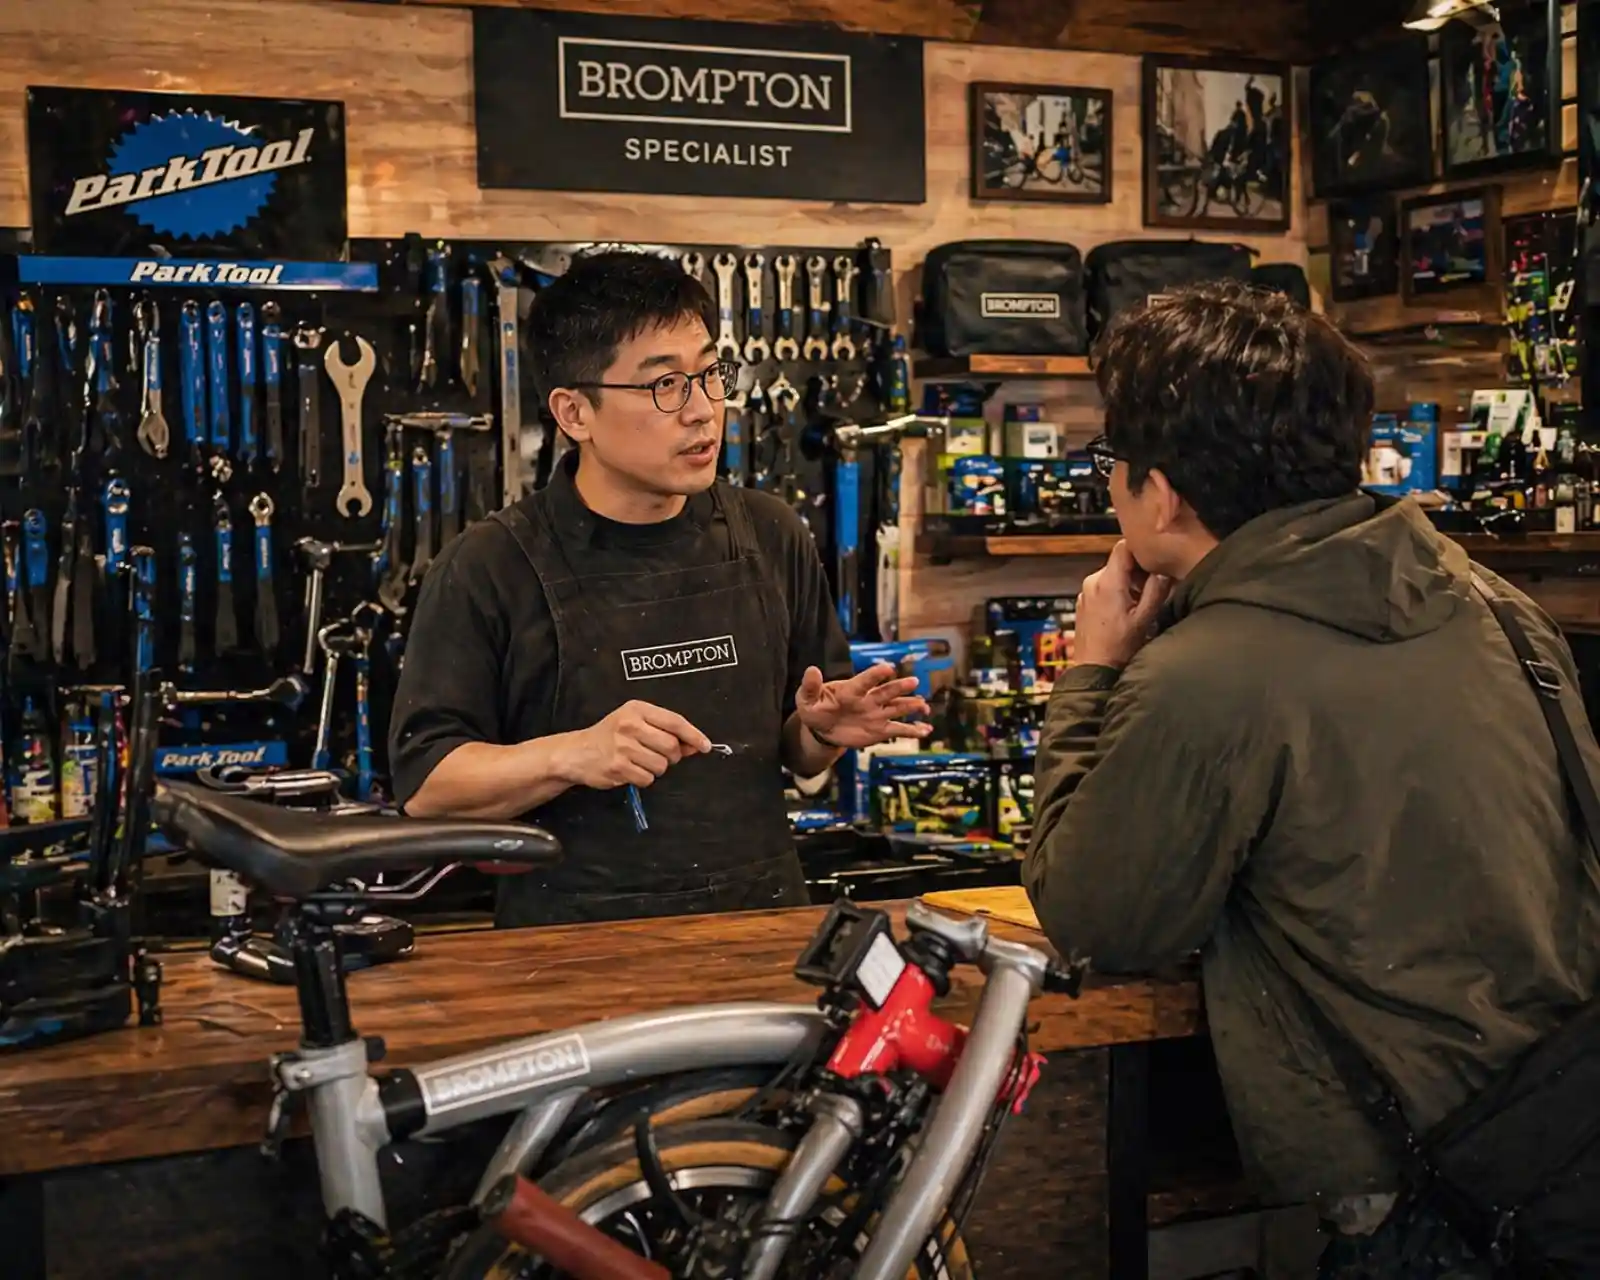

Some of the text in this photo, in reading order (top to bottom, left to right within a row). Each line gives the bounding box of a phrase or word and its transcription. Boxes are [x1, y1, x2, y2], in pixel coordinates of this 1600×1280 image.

[577, 60, 833, 111] BROMPTON
[624, 138, 793, 167] SPECIALIST
[628, 643, 730, 672] BROMPTON
[433, 1044, 577, 1100] BROMPTON
